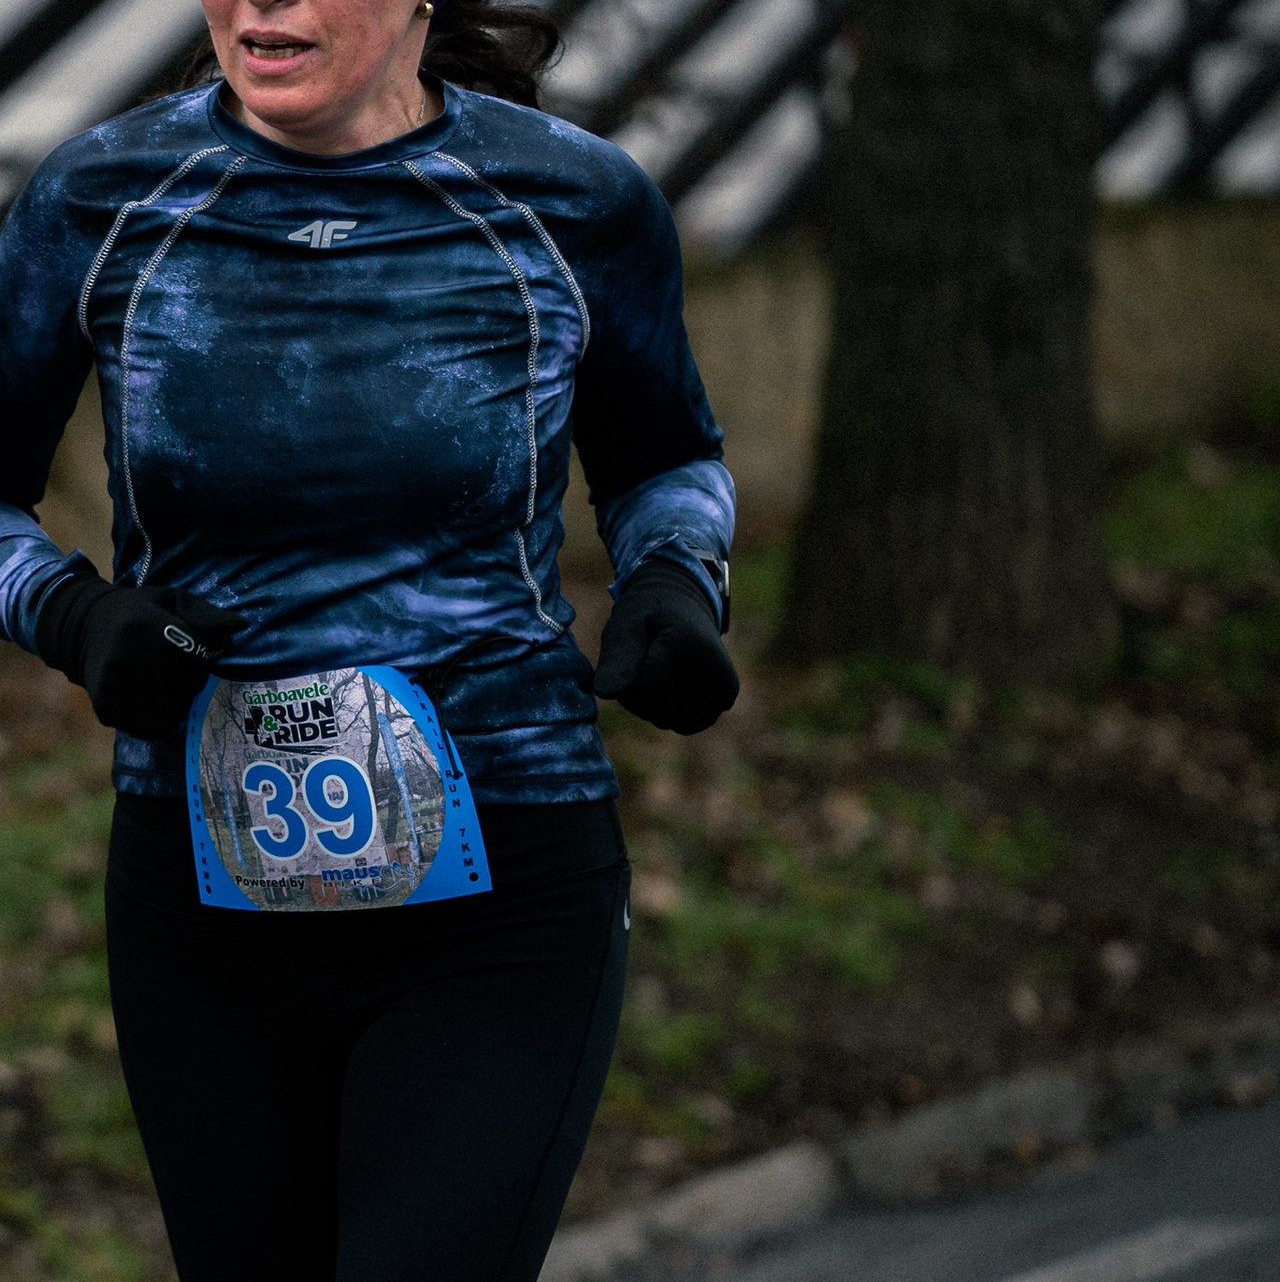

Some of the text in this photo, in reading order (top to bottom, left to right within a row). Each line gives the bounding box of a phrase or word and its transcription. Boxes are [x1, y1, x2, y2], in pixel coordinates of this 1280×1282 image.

[288, 220, 357, 248] 4F
[242, 682, 329, 705] Gârboavele
[268, 697, 335, 724] RUN
[274, 718, 338, 744] RIDE
[243, 756, 376, 858] 39
[235, 875, 305, 890] Powered by
[321, 865, 380, 881] maus
